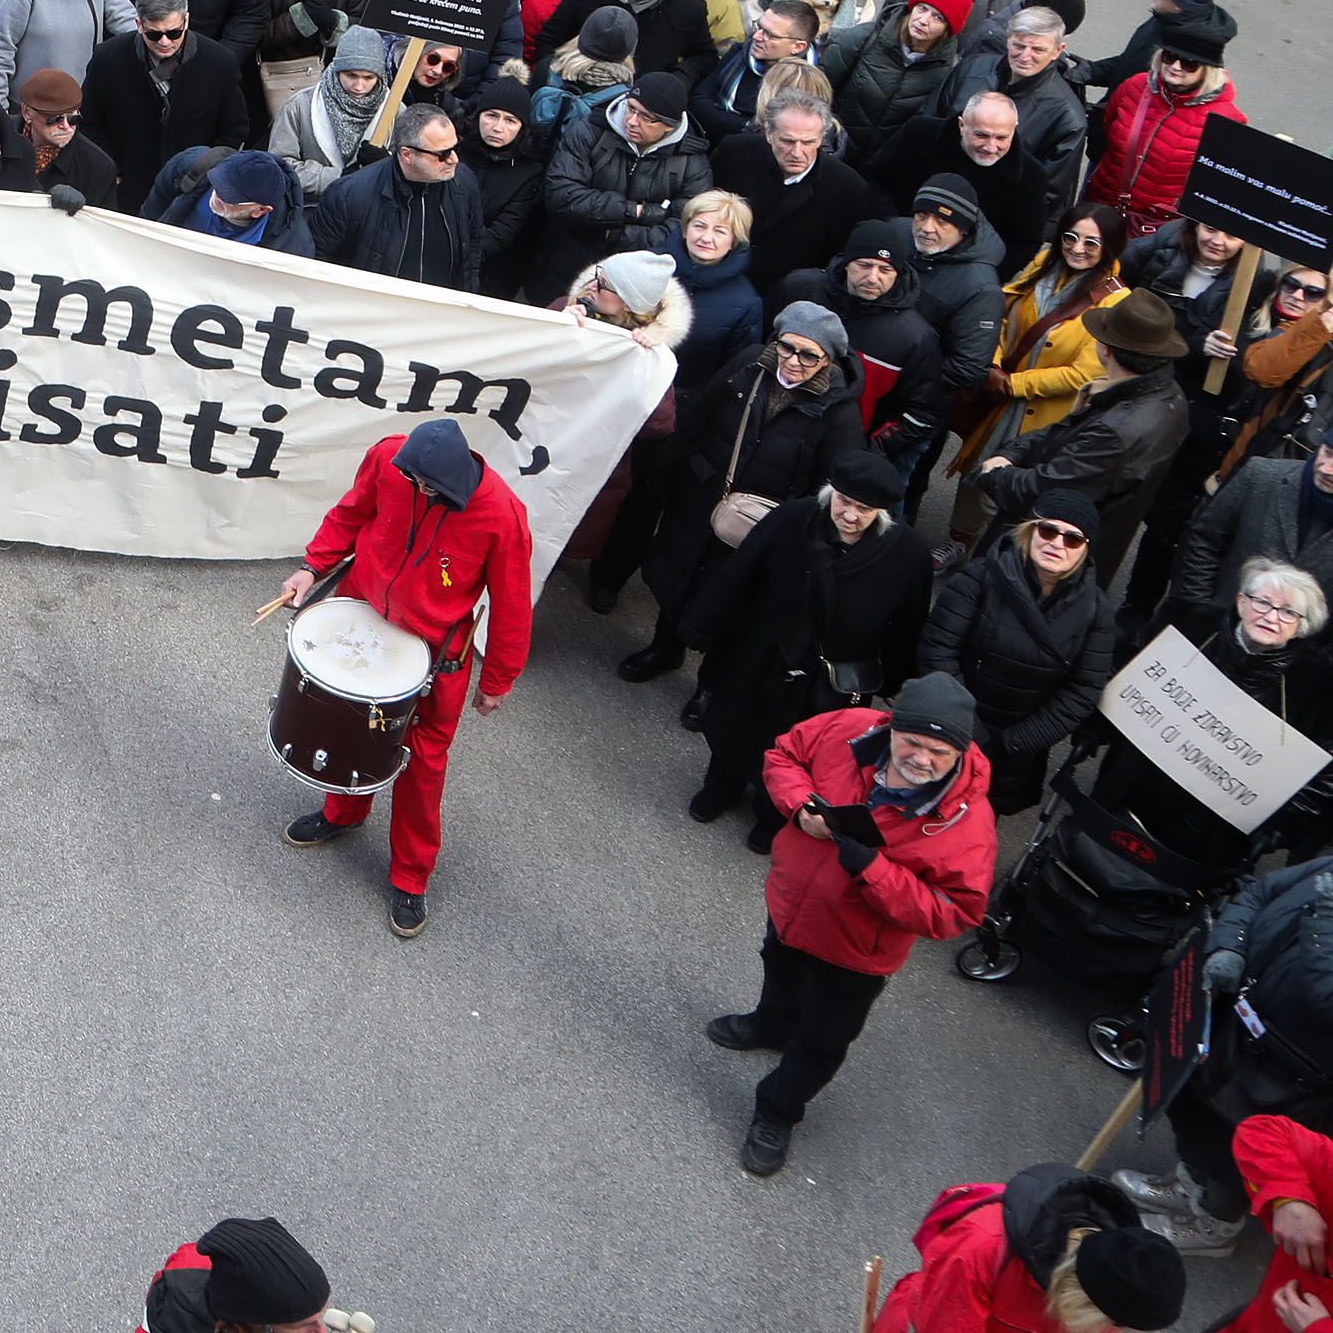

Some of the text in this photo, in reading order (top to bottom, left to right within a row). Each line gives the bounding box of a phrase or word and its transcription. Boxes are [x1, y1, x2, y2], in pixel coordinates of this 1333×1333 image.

[458, 5, 482, 15] puno.
[1198, 156, 1214, 167] Ma
[1215, 164, 1246, 181] molim
[1247, 177, 1264, 188] vas
[1265, 185, 1292, 199] malu
[1120, 685, 1164, 728] UPISATI
[1161, 725, 1181, 743] ĆU
[1144, 661, 1167, 681] ZA
[1192, 710, 1263, 766] ZDRAVSTVO
